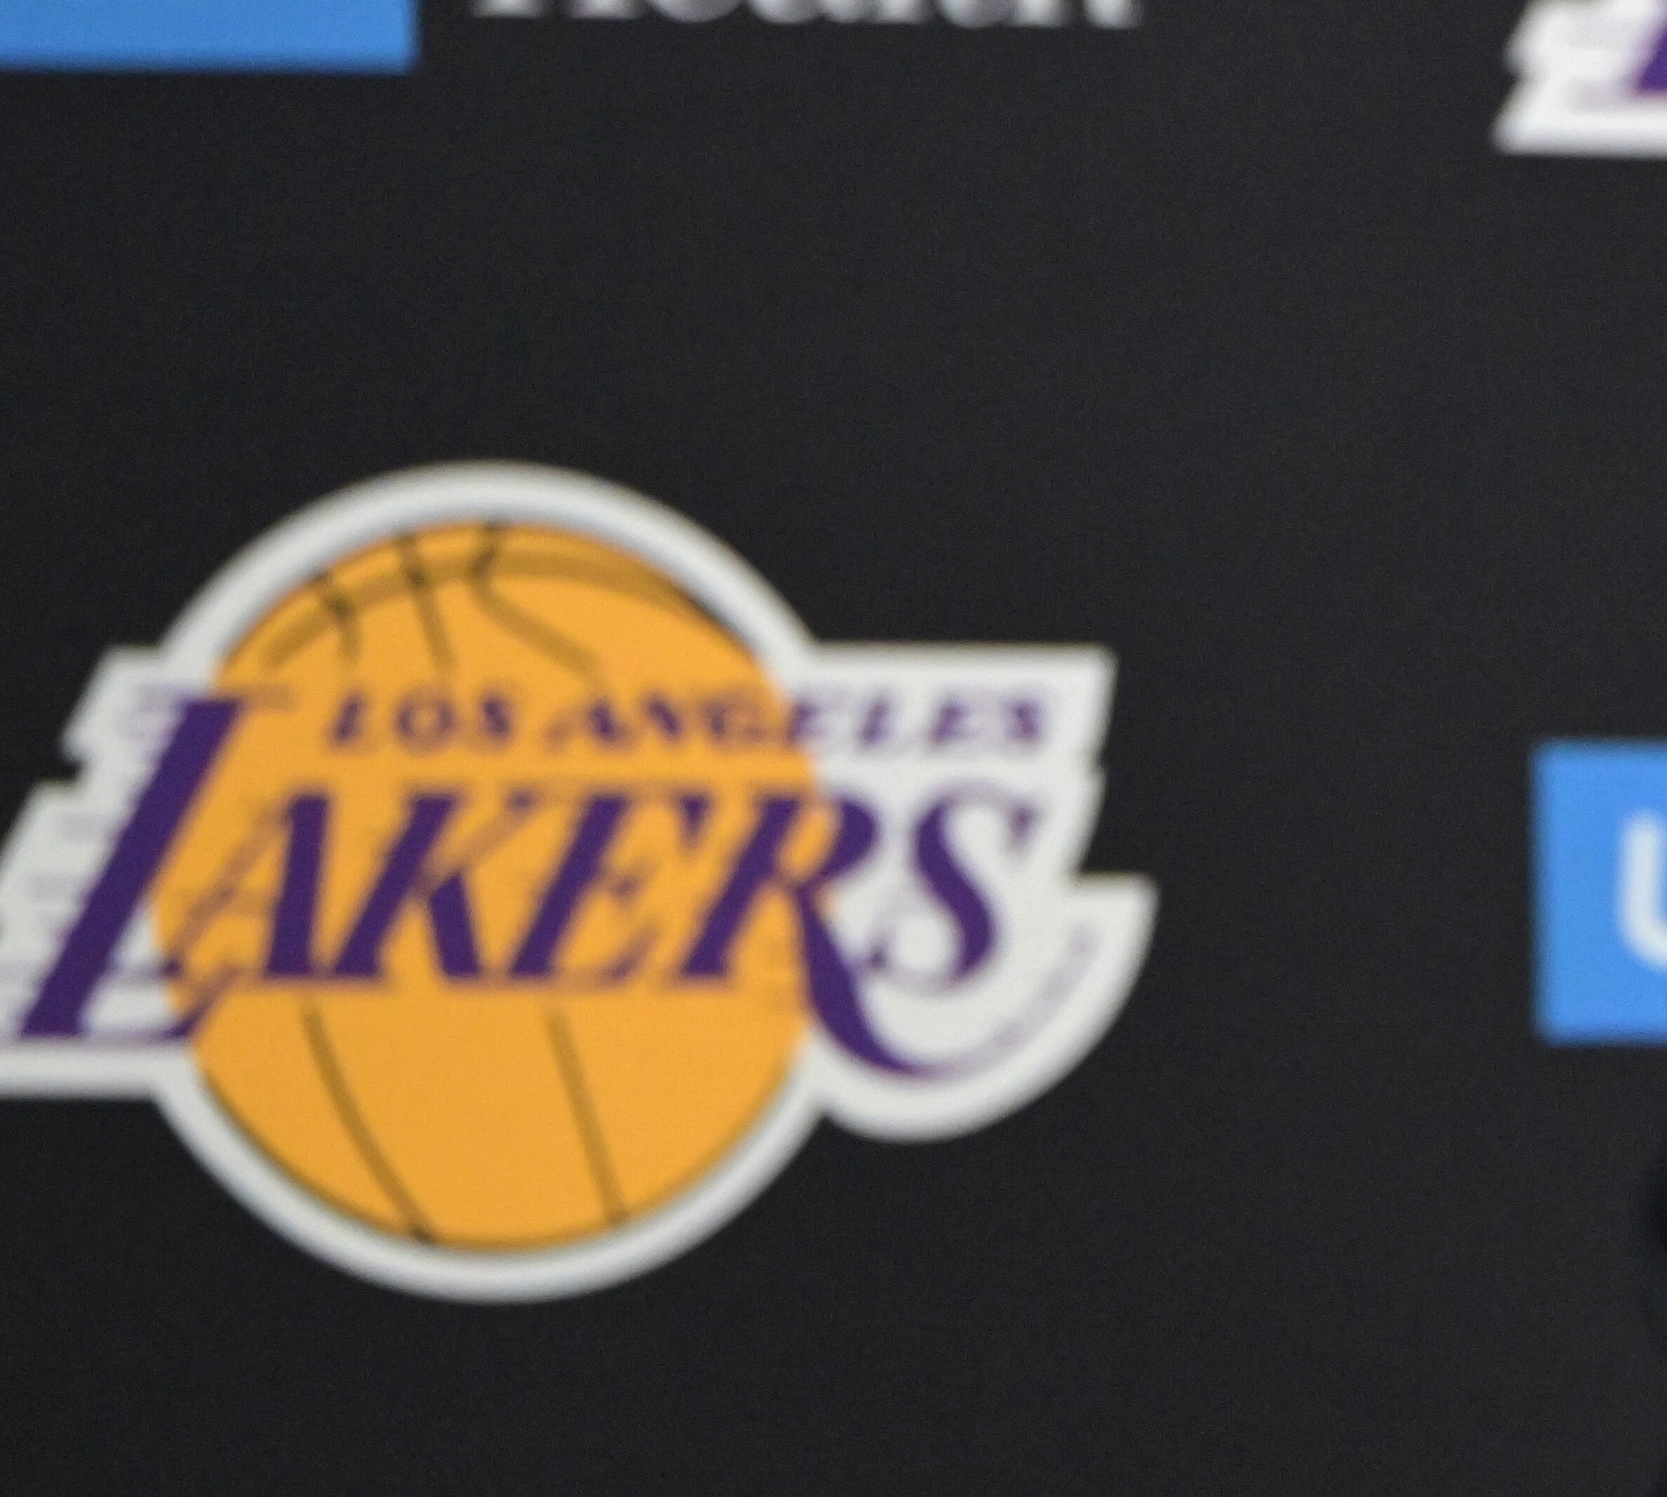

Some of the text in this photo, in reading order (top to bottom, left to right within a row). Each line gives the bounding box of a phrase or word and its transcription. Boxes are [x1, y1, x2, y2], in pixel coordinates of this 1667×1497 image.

[325, 685, 1050, 759] LOS ANGELES
[10, 686, 1096, 1080] LAKERS
